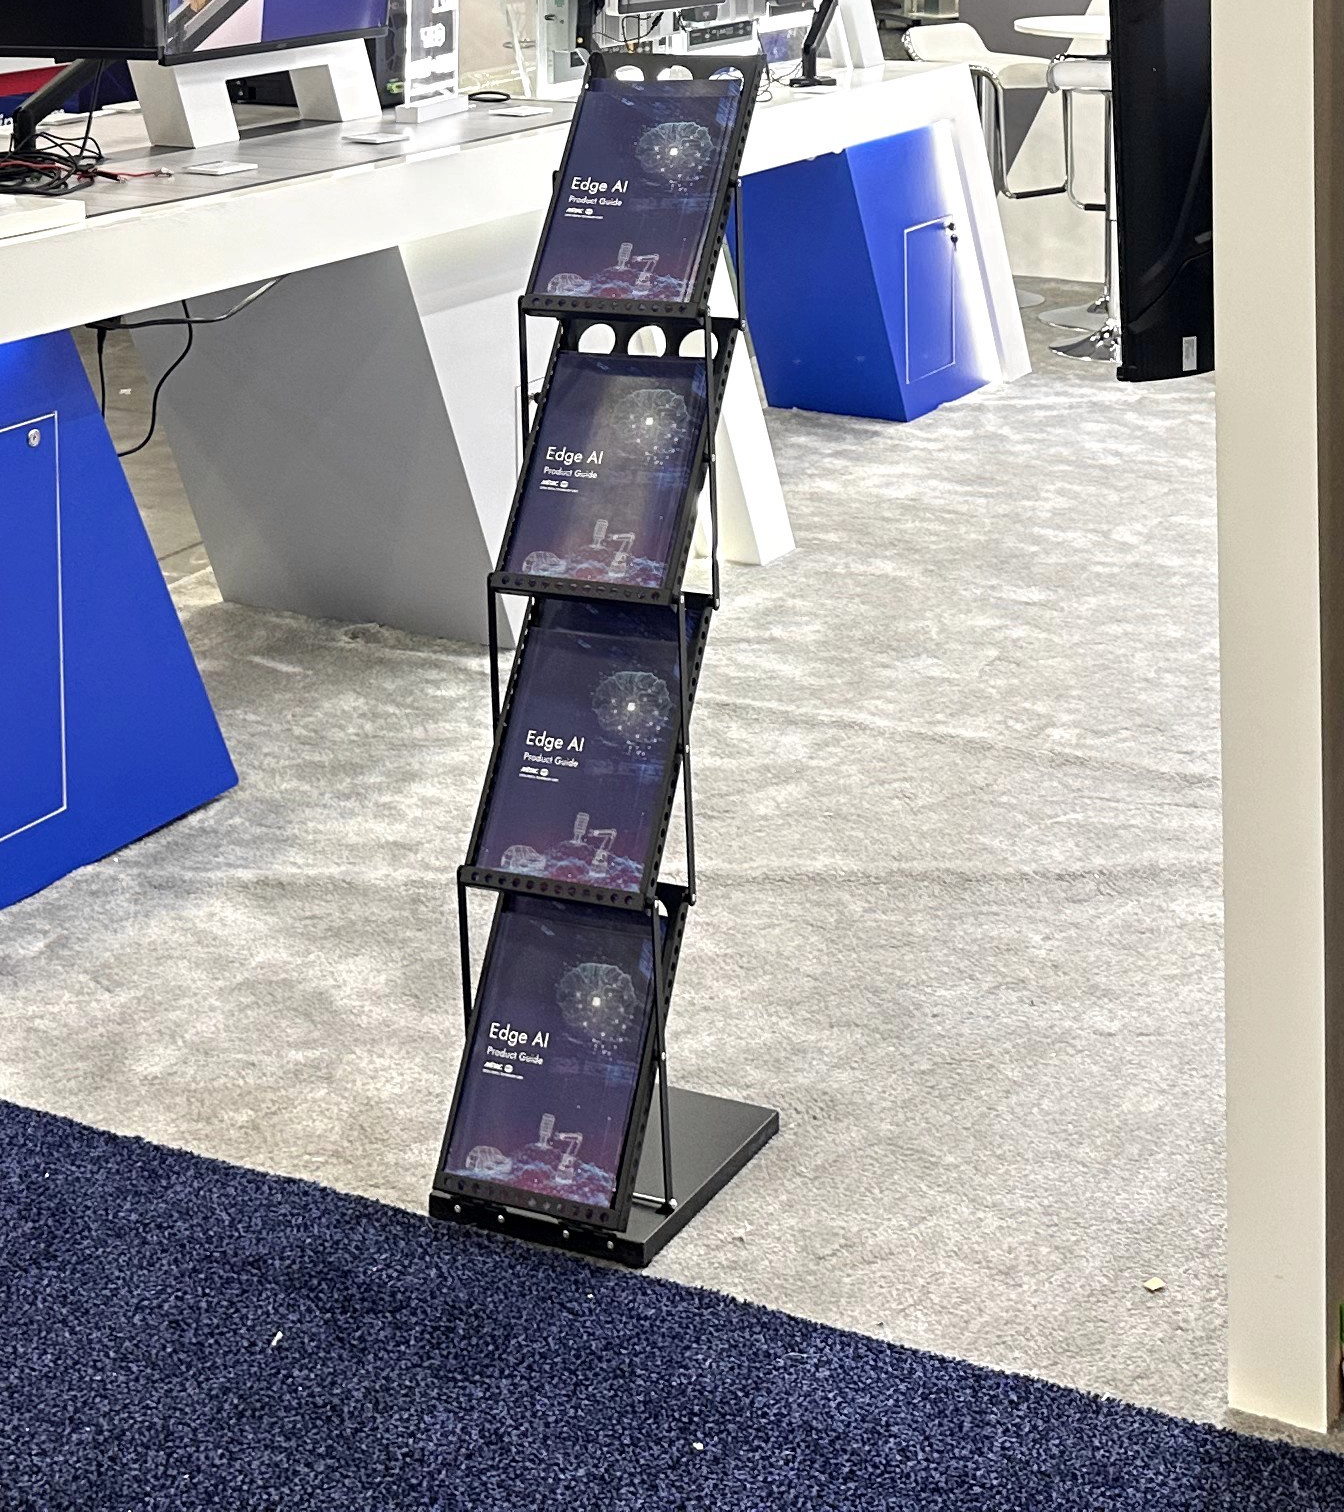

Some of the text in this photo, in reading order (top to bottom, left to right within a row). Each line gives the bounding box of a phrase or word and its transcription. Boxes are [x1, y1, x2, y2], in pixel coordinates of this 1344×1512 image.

[571, 176, 629, 195] Edge AI
[568, 194, 623, 206] Product Guide
[546, 446, 604, 466] Edge AI
[543, 466, 598, 479] Product Guide
[526, 730, 585, 752] Edge AI
[523, 751, 579, 768] Product Guide
[489, 1022, 550, 1048] Edge AI
[486, 1045, 544, 1065] Product Guide
